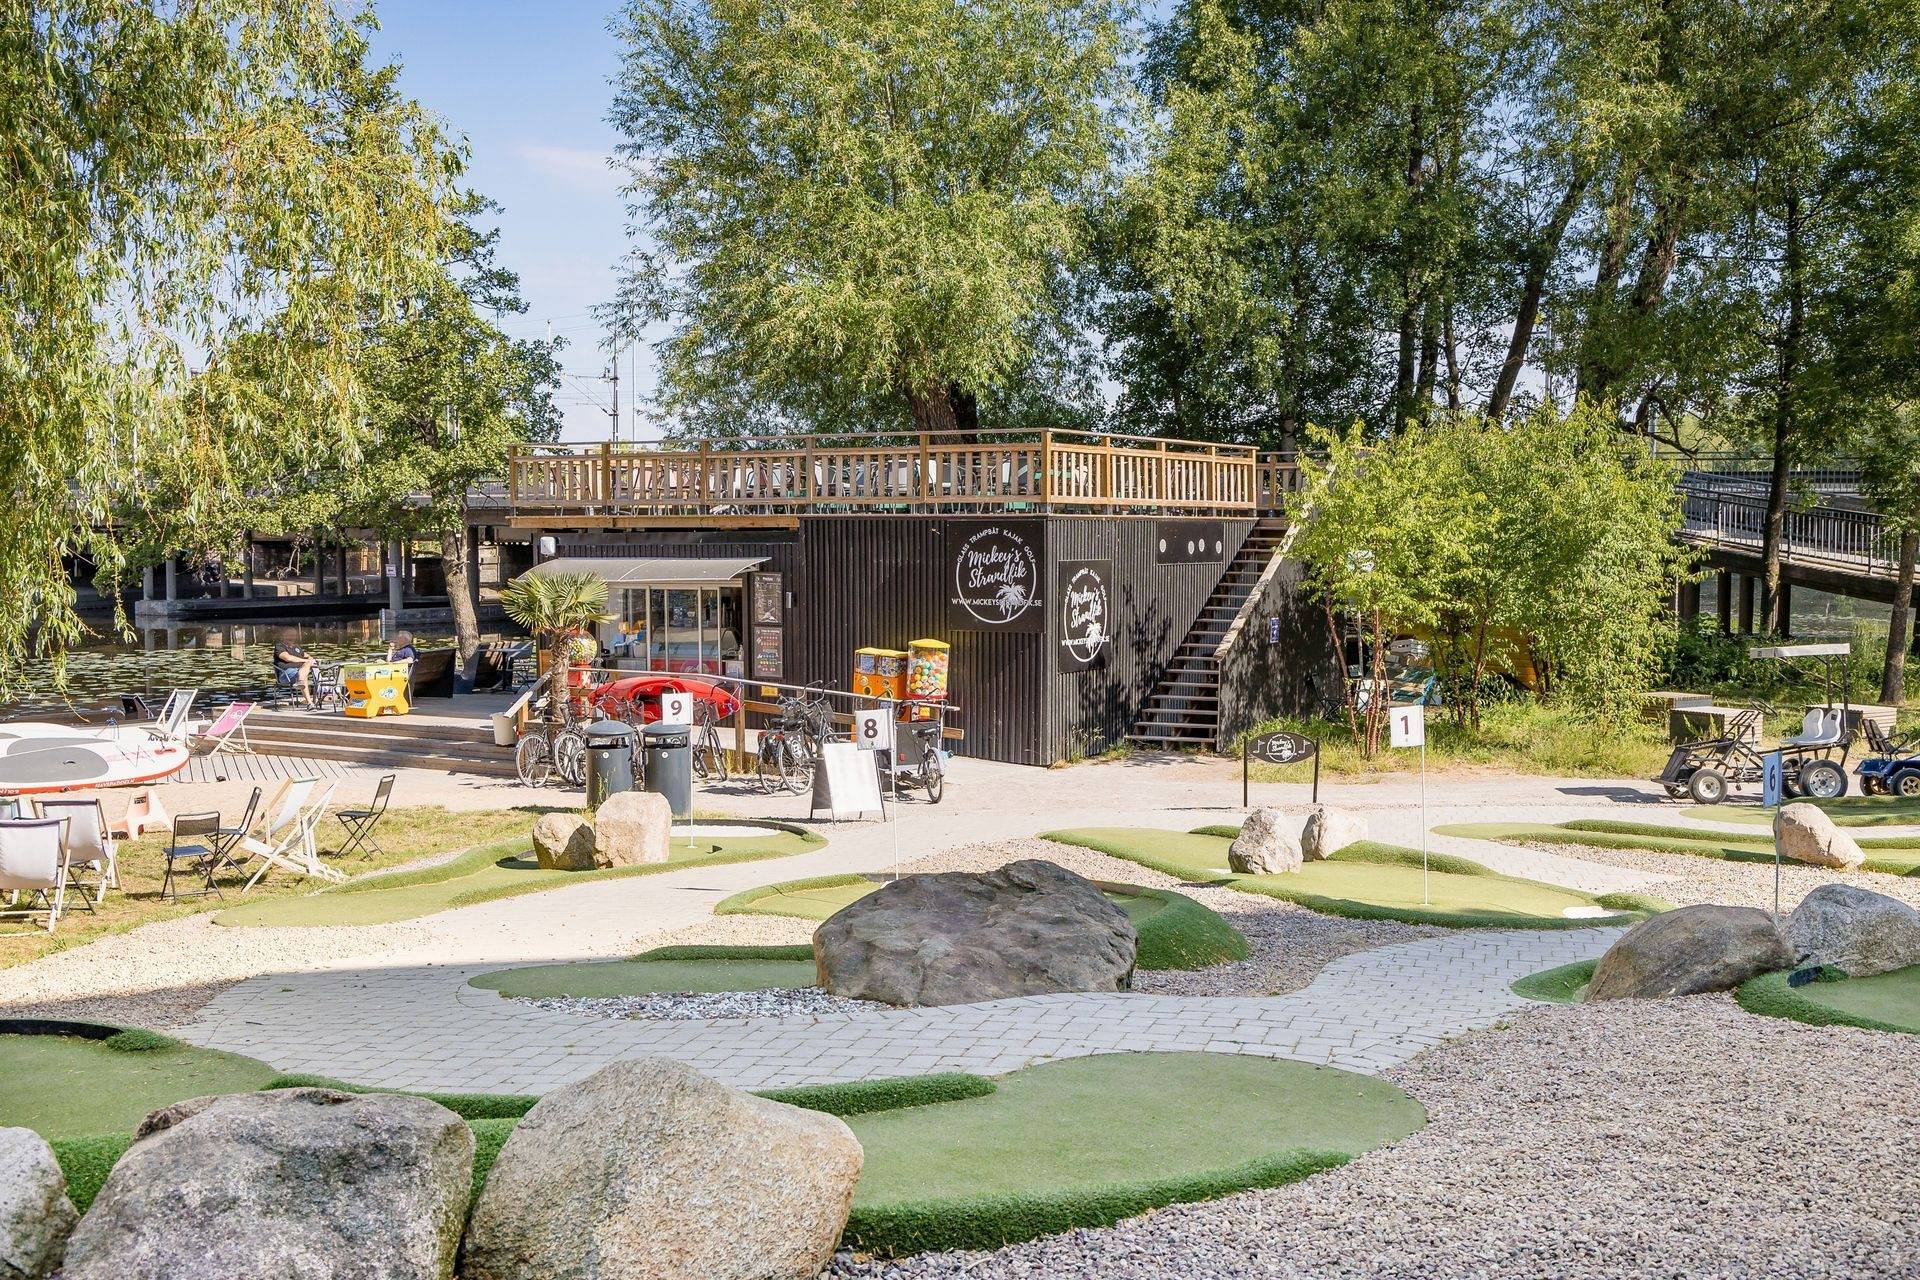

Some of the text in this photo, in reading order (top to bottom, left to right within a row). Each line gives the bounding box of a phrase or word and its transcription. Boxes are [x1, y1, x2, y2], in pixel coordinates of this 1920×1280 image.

[967, 545, 1022, 569] Mickey's
[969, 527, 999, 544] TRAMPBÅT
[1003, 529, 1023, 545] KAJAK
[1024, 545, 1037, 563] GOLF
[968, 560, 1028, 588] Strandfik
[670, 700, 682, 715] 9
[864, 718, 878, 739] 8
[1400, 715, 1409, 735] 1
[1769, 764, 1776, 792] 6
